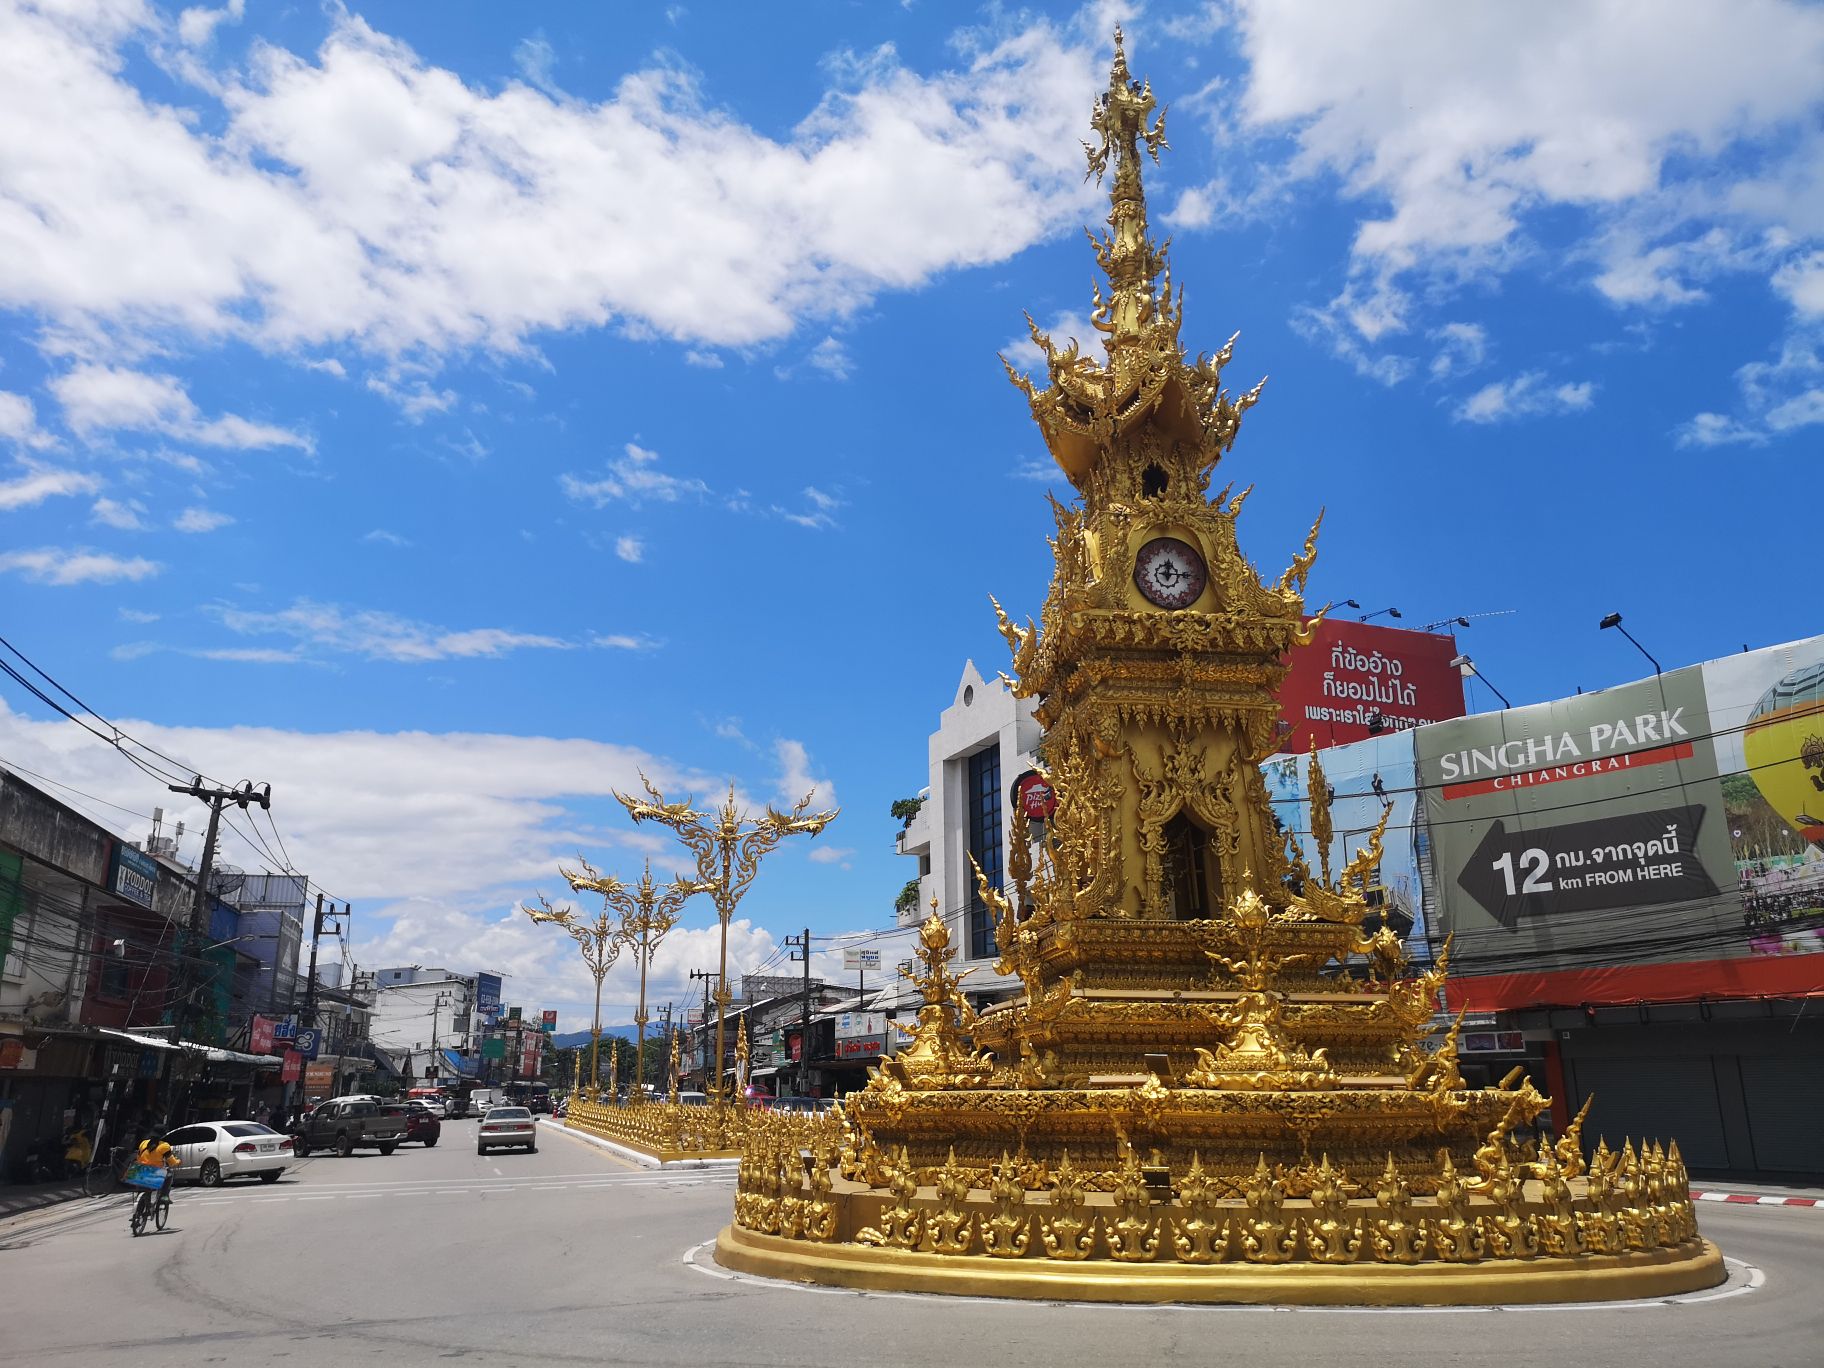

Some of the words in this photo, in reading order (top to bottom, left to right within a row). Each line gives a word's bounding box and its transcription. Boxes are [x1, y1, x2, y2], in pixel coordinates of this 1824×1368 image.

[1331, 640, 1403, 676] กี่ข้ออ้าง
[1323, 671, 1416, 706] ก็ยอมไม่ได้
[1440, 731, 1582, 780] SINGHA
[1589, 707, 1688, 752] PARK
[1493, 754, 1630, 789] CHIANGRAI
[1492, 848, 1553, 896] 12
[1555, 823, 1680, 868] กม.จากจุดนี้
[1558, 876, 1583, 890] km
[1585, 868, 1634, 887] FROM
[1637, 862, 1684, 881] HERE
